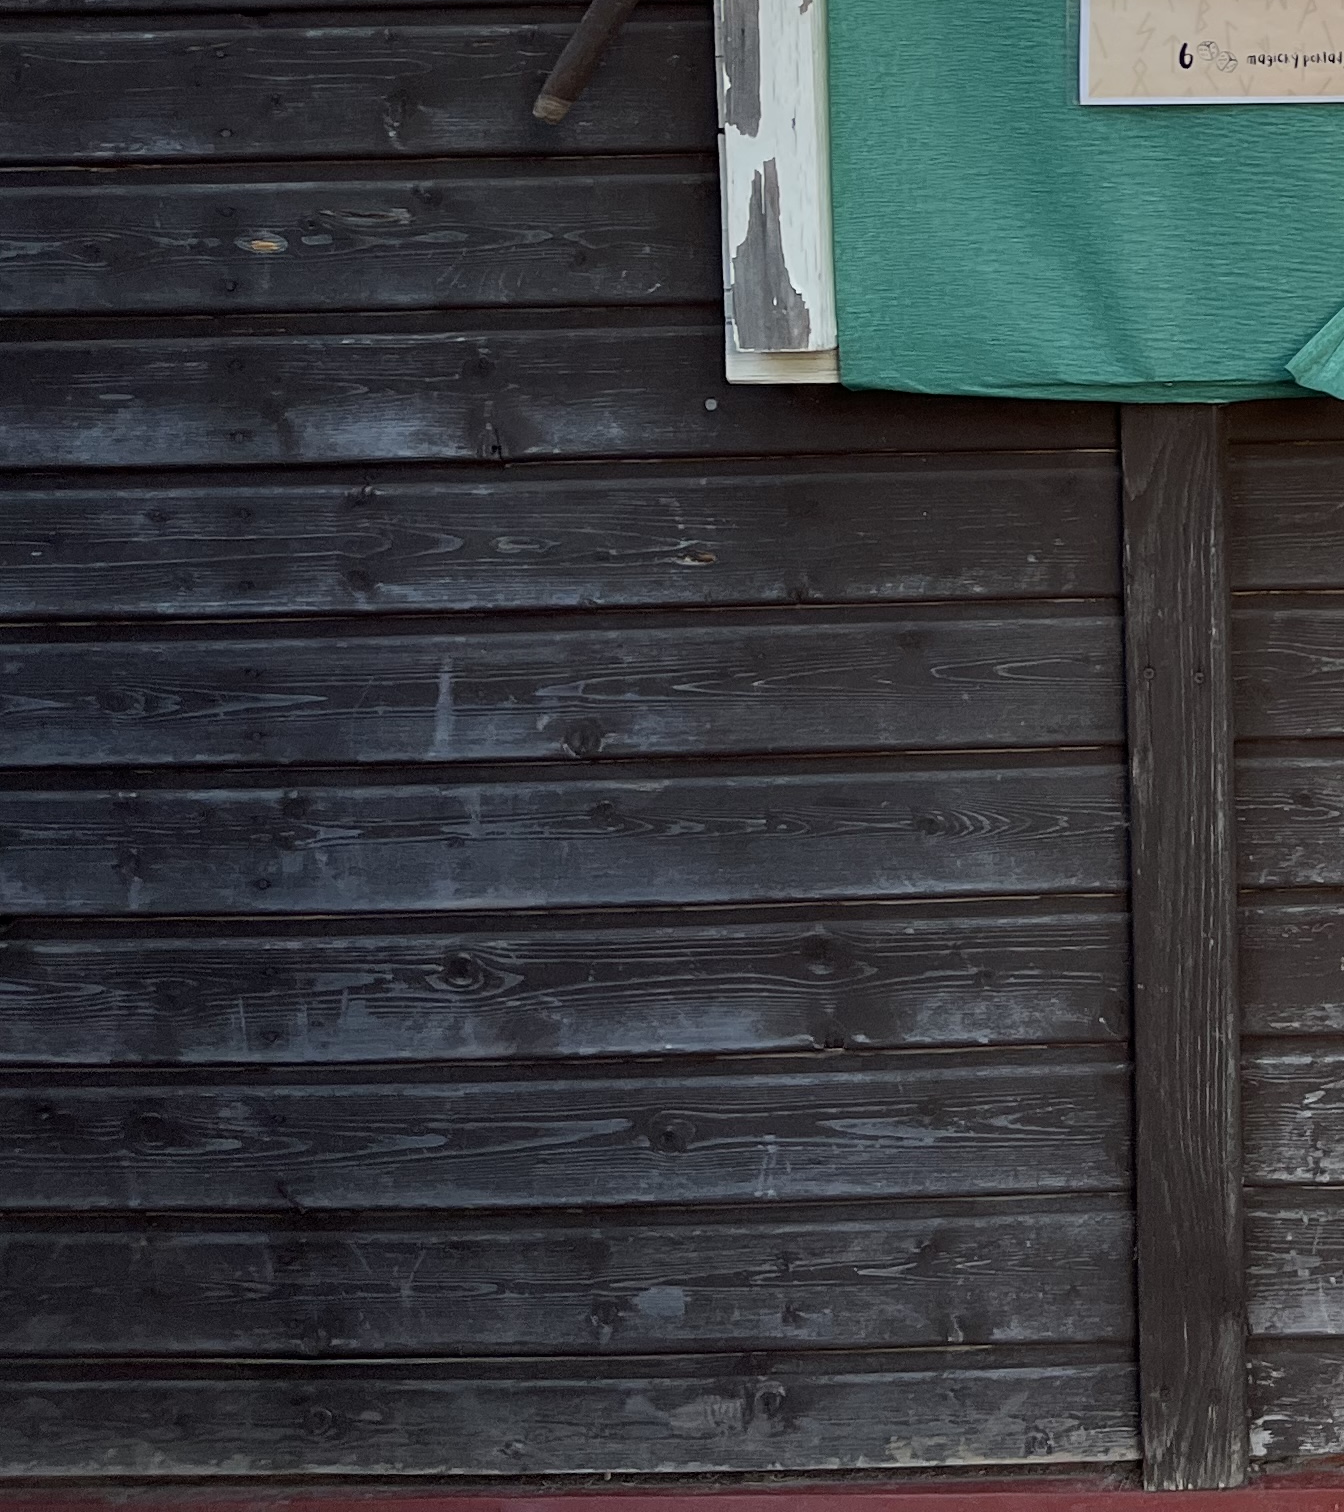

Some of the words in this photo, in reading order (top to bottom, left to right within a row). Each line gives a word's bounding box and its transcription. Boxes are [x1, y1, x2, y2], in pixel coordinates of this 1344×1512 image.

[1179, 42, 1193, 69] 6
[1246, 51, 1299, 69] magický
[1303, 51, 1343, 67] poklad
